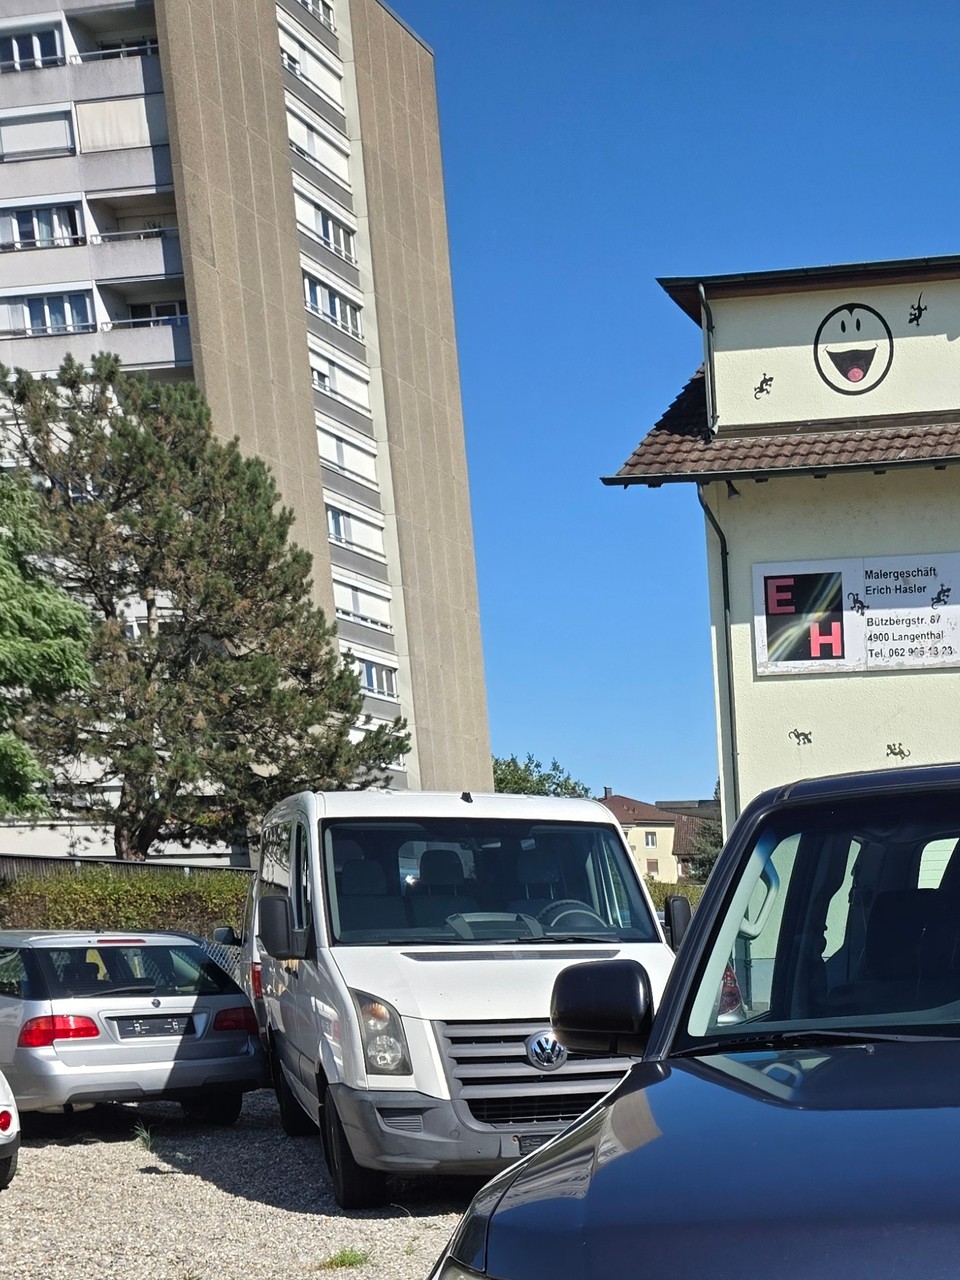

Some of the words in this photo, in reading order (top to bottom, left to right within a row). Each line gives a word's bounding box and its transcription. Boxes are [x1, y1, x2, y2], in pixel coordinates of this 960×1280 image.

[865, 567, 937, 581] Malergeschäft
[767, 578, 796, 614] E
[865, 585, 892, 595] Erich
[895, 584, 927, 594] Hasler
[866, 616, 928, 628] Bützbergstr.
[809, 621, 842, 657] H
[867, 632, 890, 642] 4900
[892, 630, 944, 643] Langenthal
[868, 648, 886, 658] Tel.
[889, 647, 906, 657] 062
